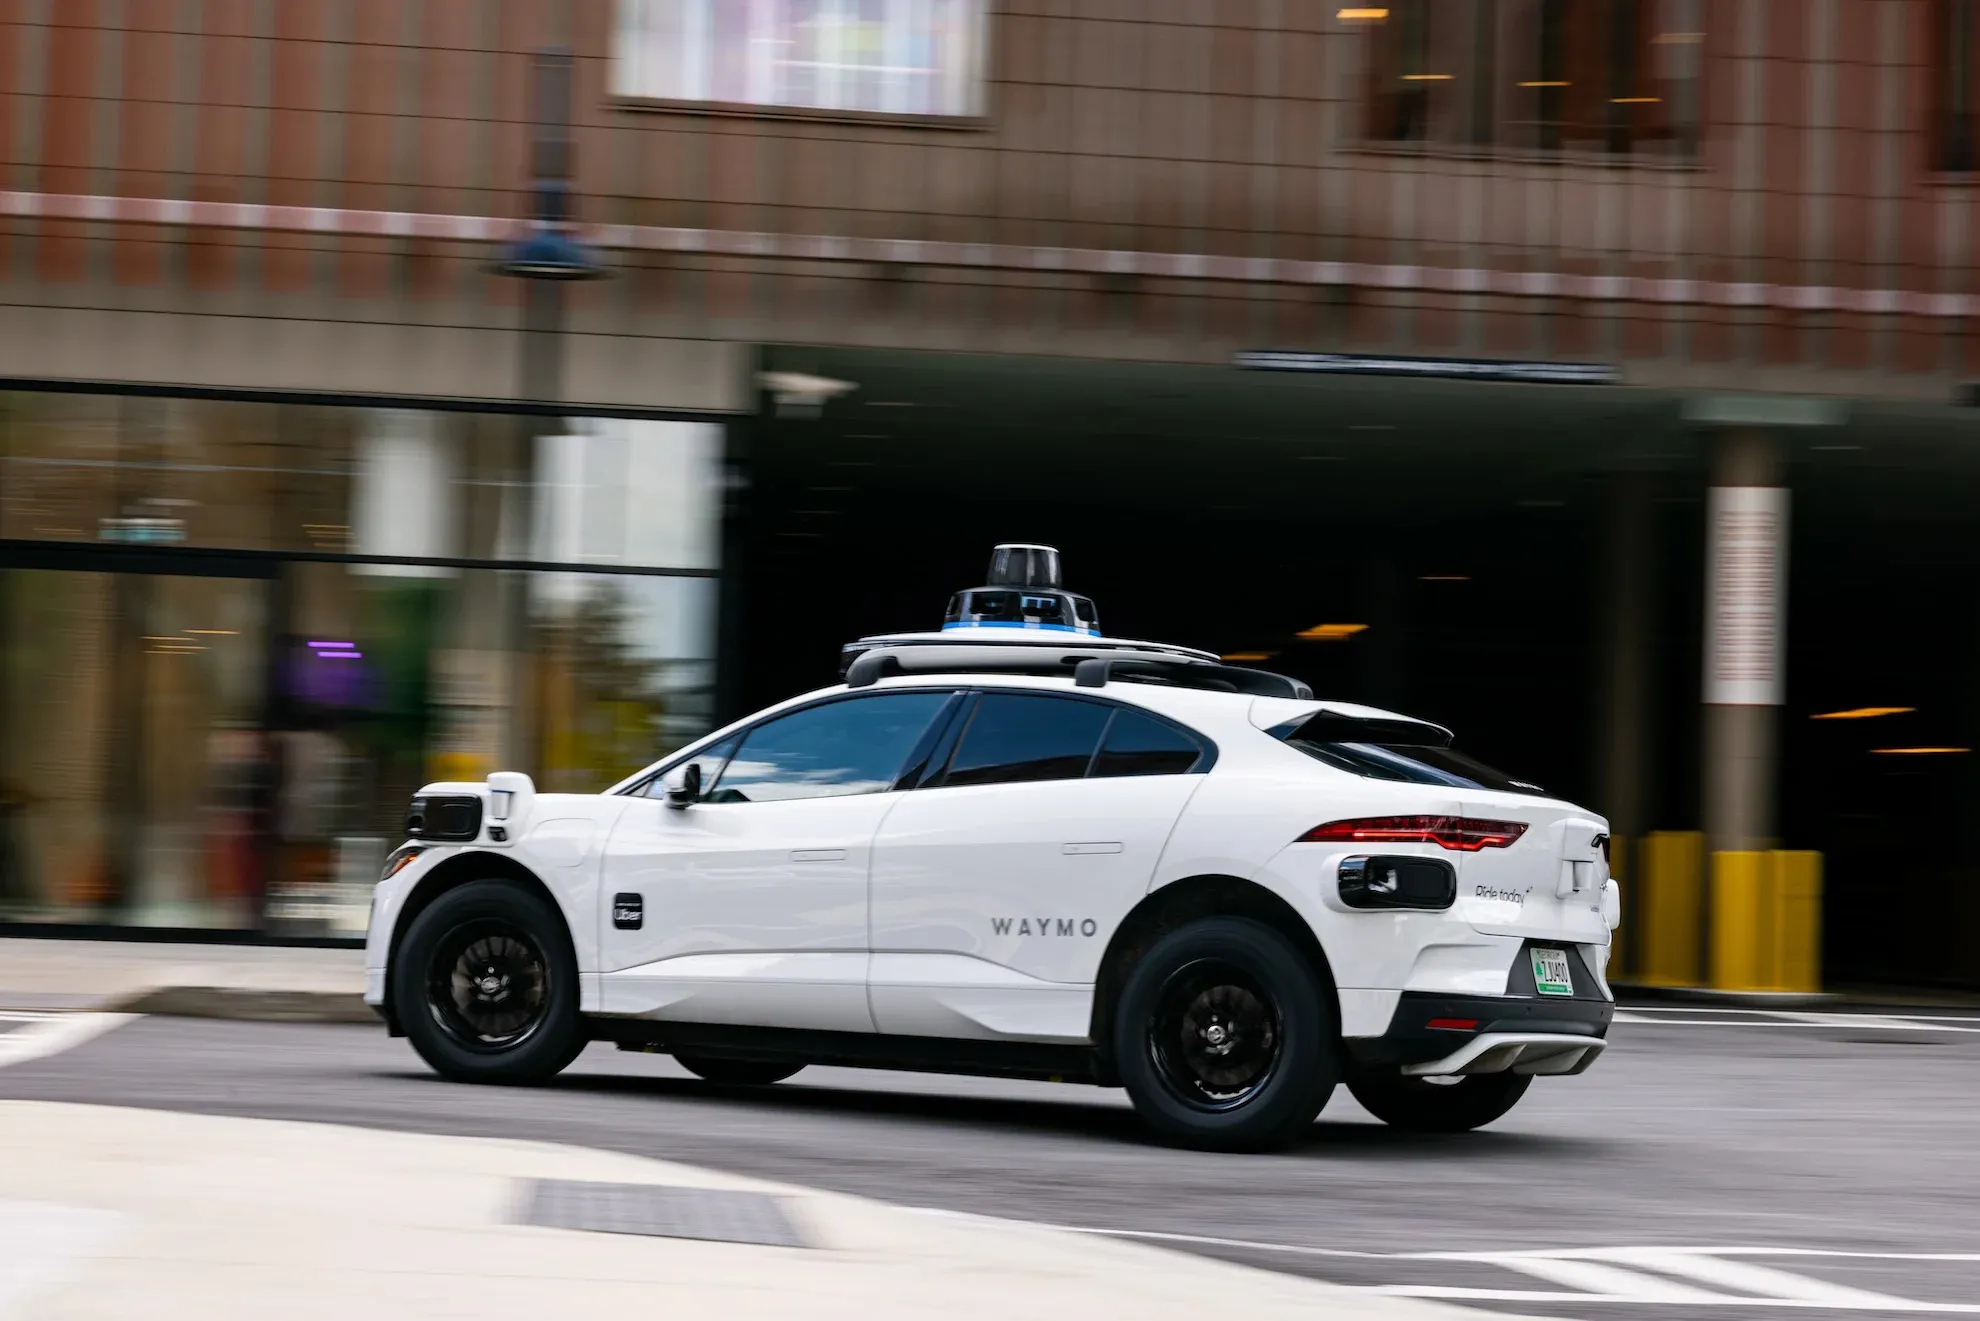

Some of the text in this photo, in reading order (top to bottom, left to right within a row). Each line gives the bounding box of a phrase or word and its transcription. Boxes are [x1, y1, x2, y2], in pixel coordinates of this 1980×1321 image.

[1475, 885, 1525, 908] Ride today
[614, 908, 642, 921] Uber
[991, 918, 1097, 937] WAYMO
